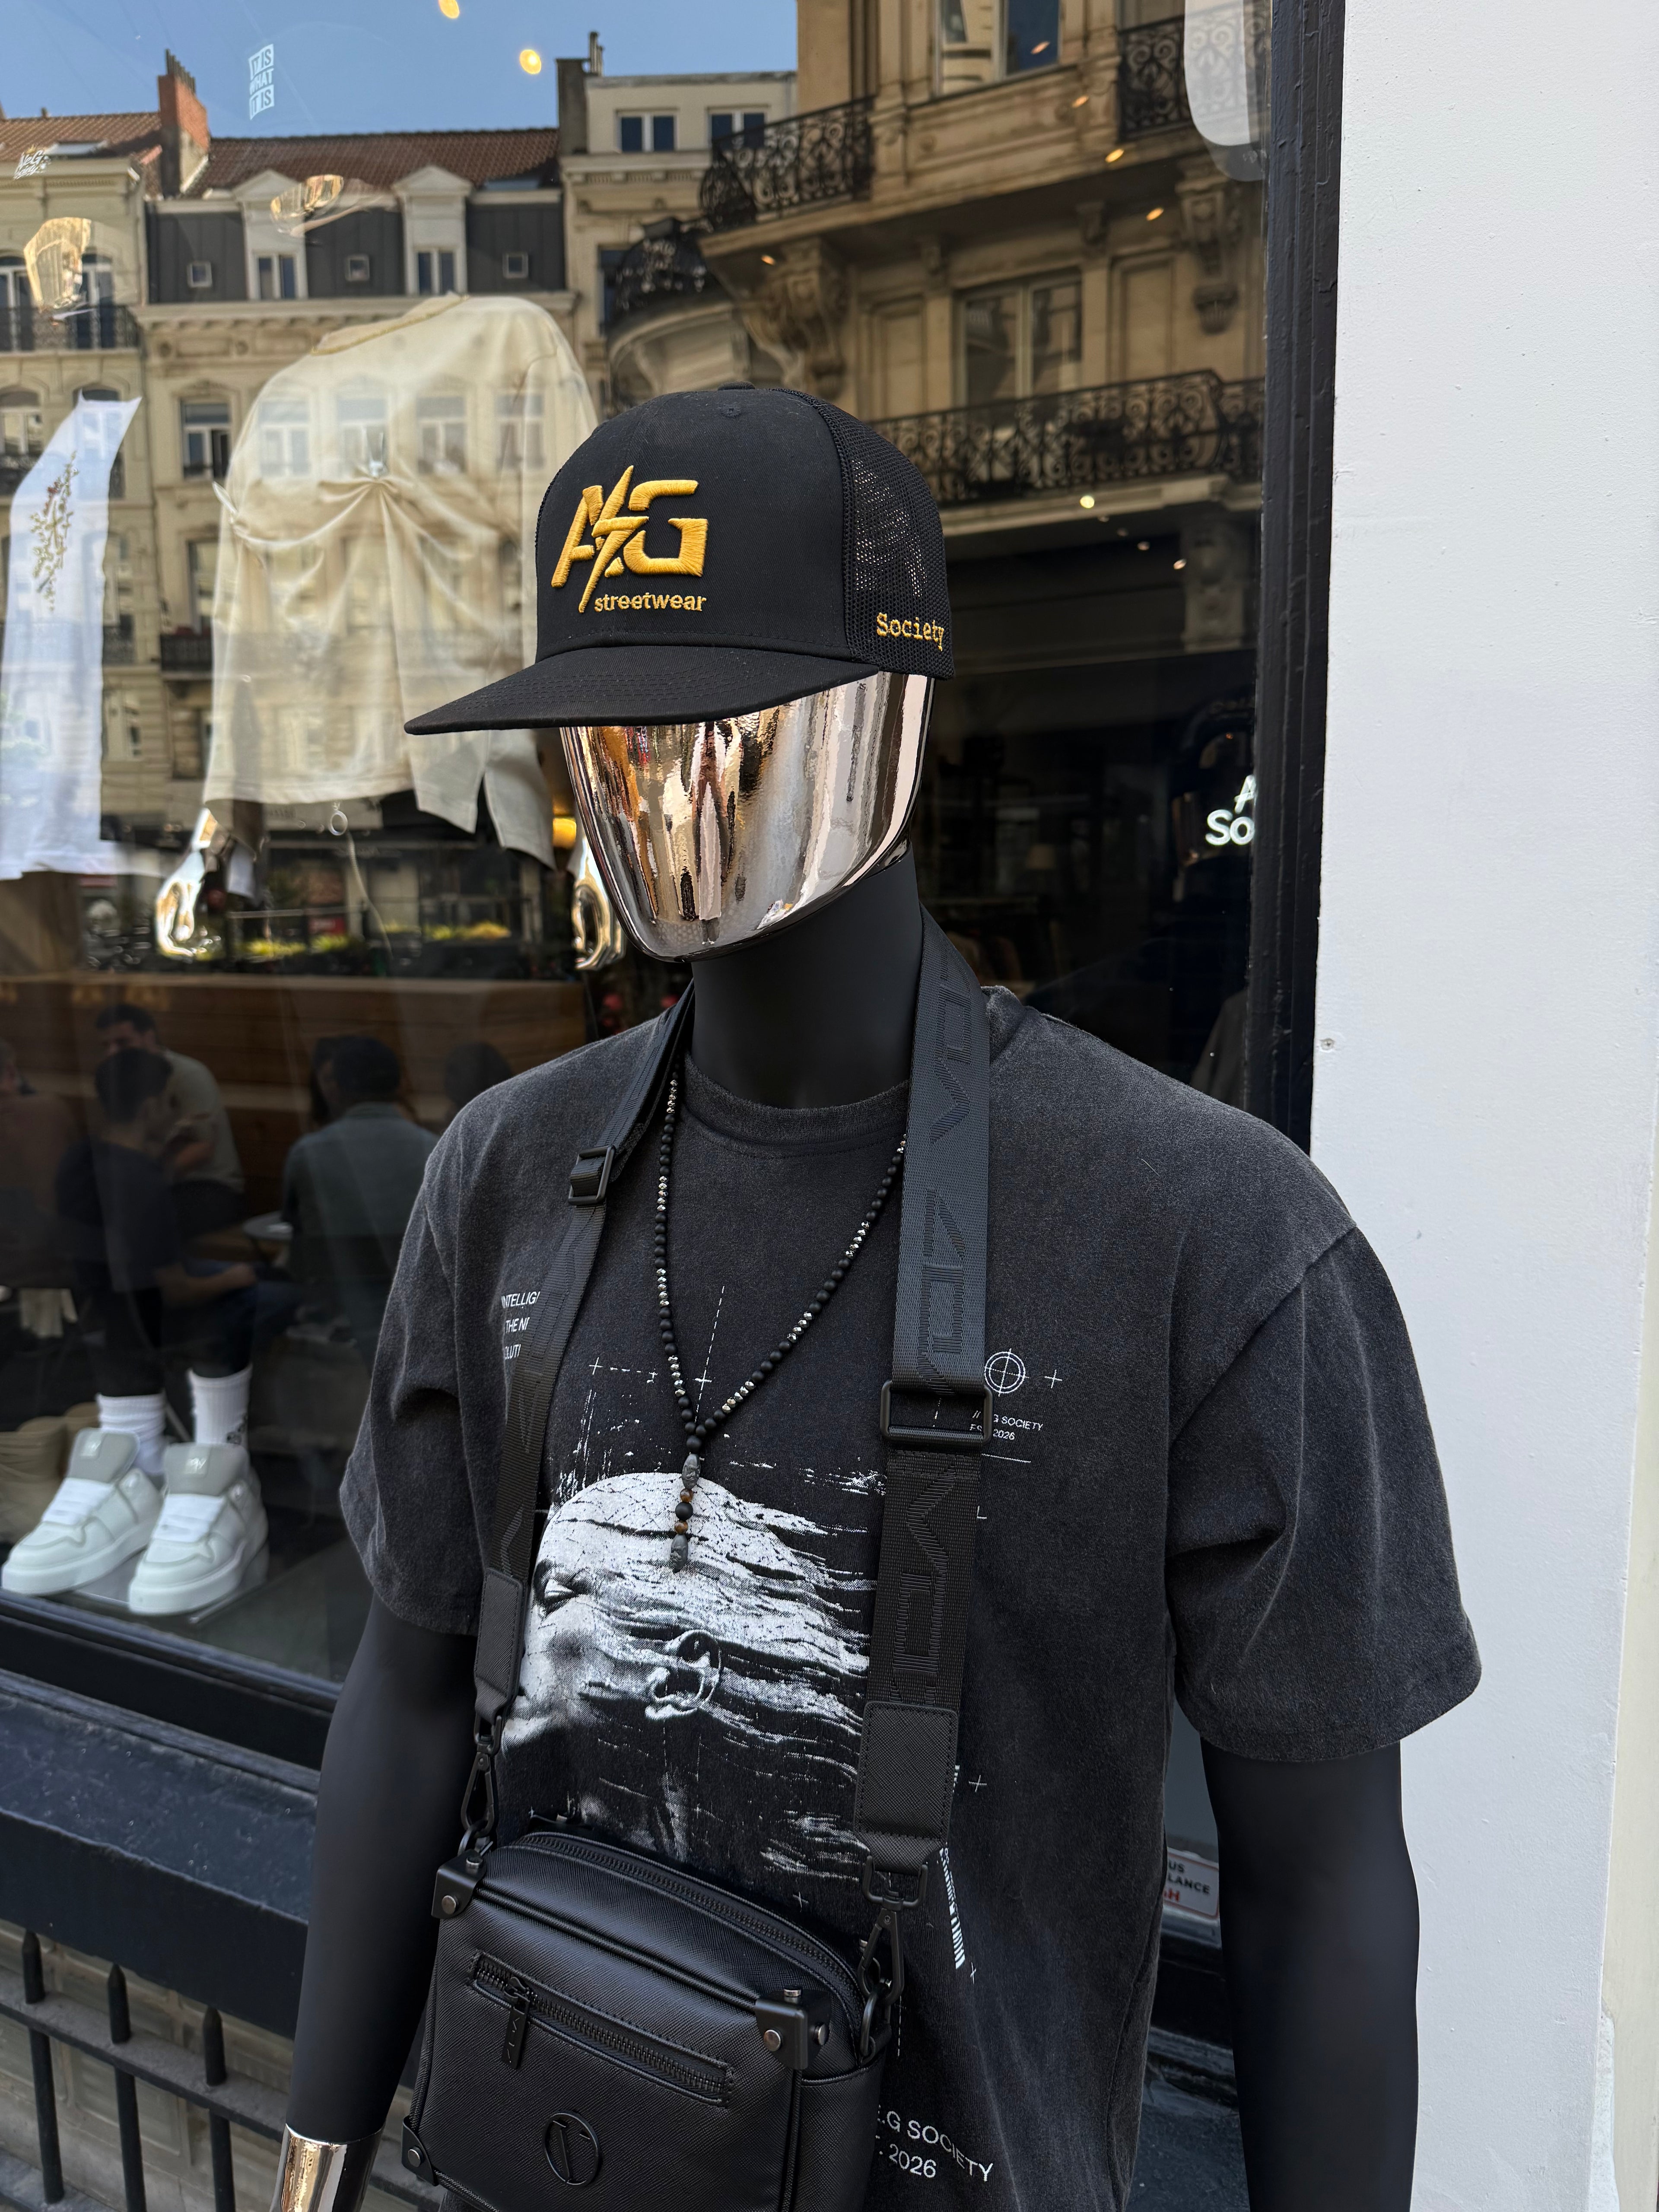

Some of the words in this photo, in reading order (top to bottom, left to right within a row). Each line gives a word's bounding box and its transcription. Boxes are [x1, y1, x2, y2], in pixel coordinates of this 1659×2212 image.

[261, 48, 271, 68] IS
[249, 68, 274, 95] WHAT
[251, 95, 259, 116] IT
[261, 89, 272, 108] IS
[594, 592, 707, 612] streetwear
[877, 612, 944, 652] Society
[505, 1318, 519, 1333] THE
[993, 1429, 1015, 1440] 2026
[1001, 1416, 1043, 1431] SOCIETY
[888, 2144, 937, 2178] 2026
[907, 2120, 993, 2182] SOCIETY
